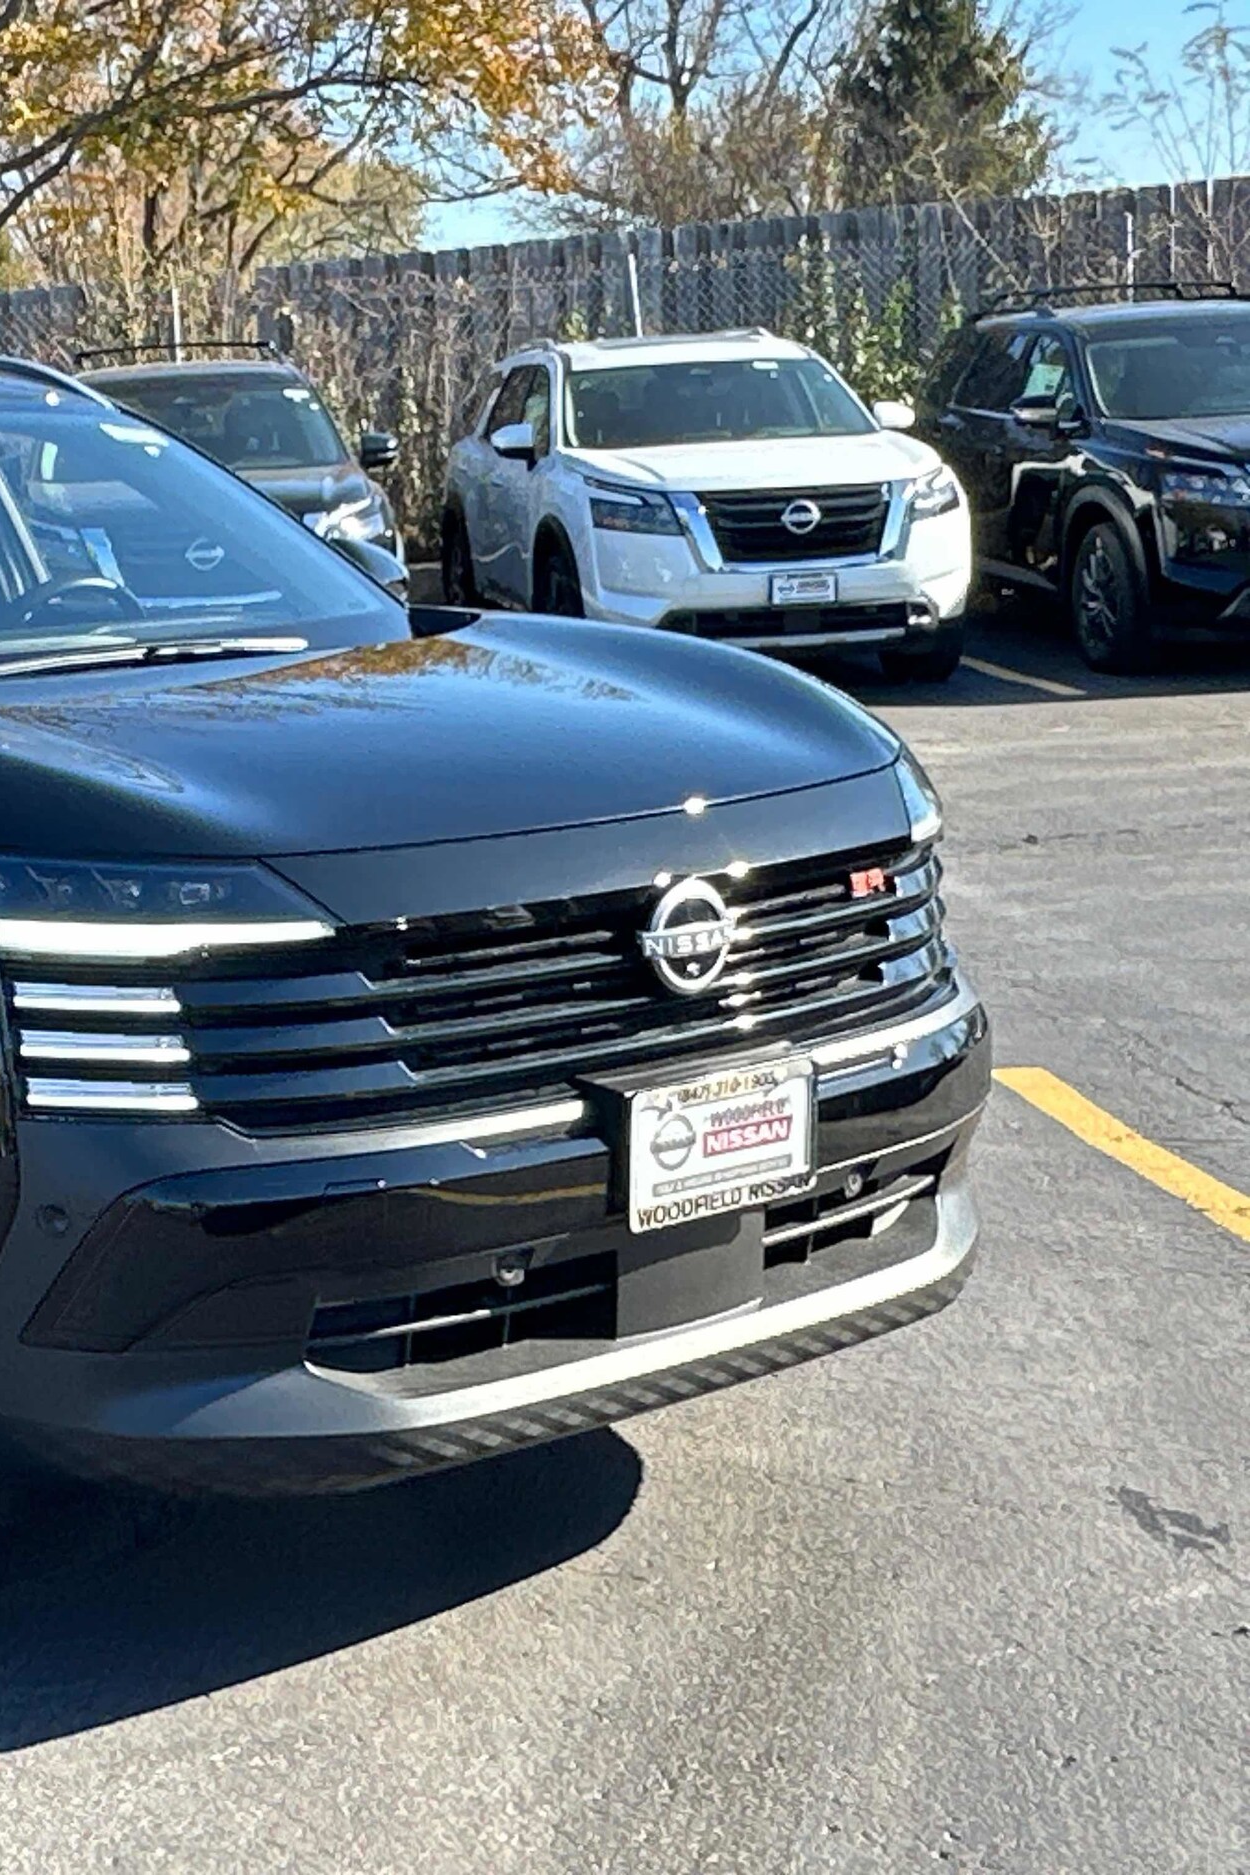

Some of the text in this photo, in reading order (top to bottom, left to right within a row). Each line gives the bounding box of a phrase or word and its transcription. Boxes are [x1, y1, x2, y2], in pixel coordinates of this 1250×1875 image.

[645, 927, 733, 957] NISSA
[706, 1119, 788, 1152] NISSAN
[637, 1187, 742, 1228] WOODFIELD
